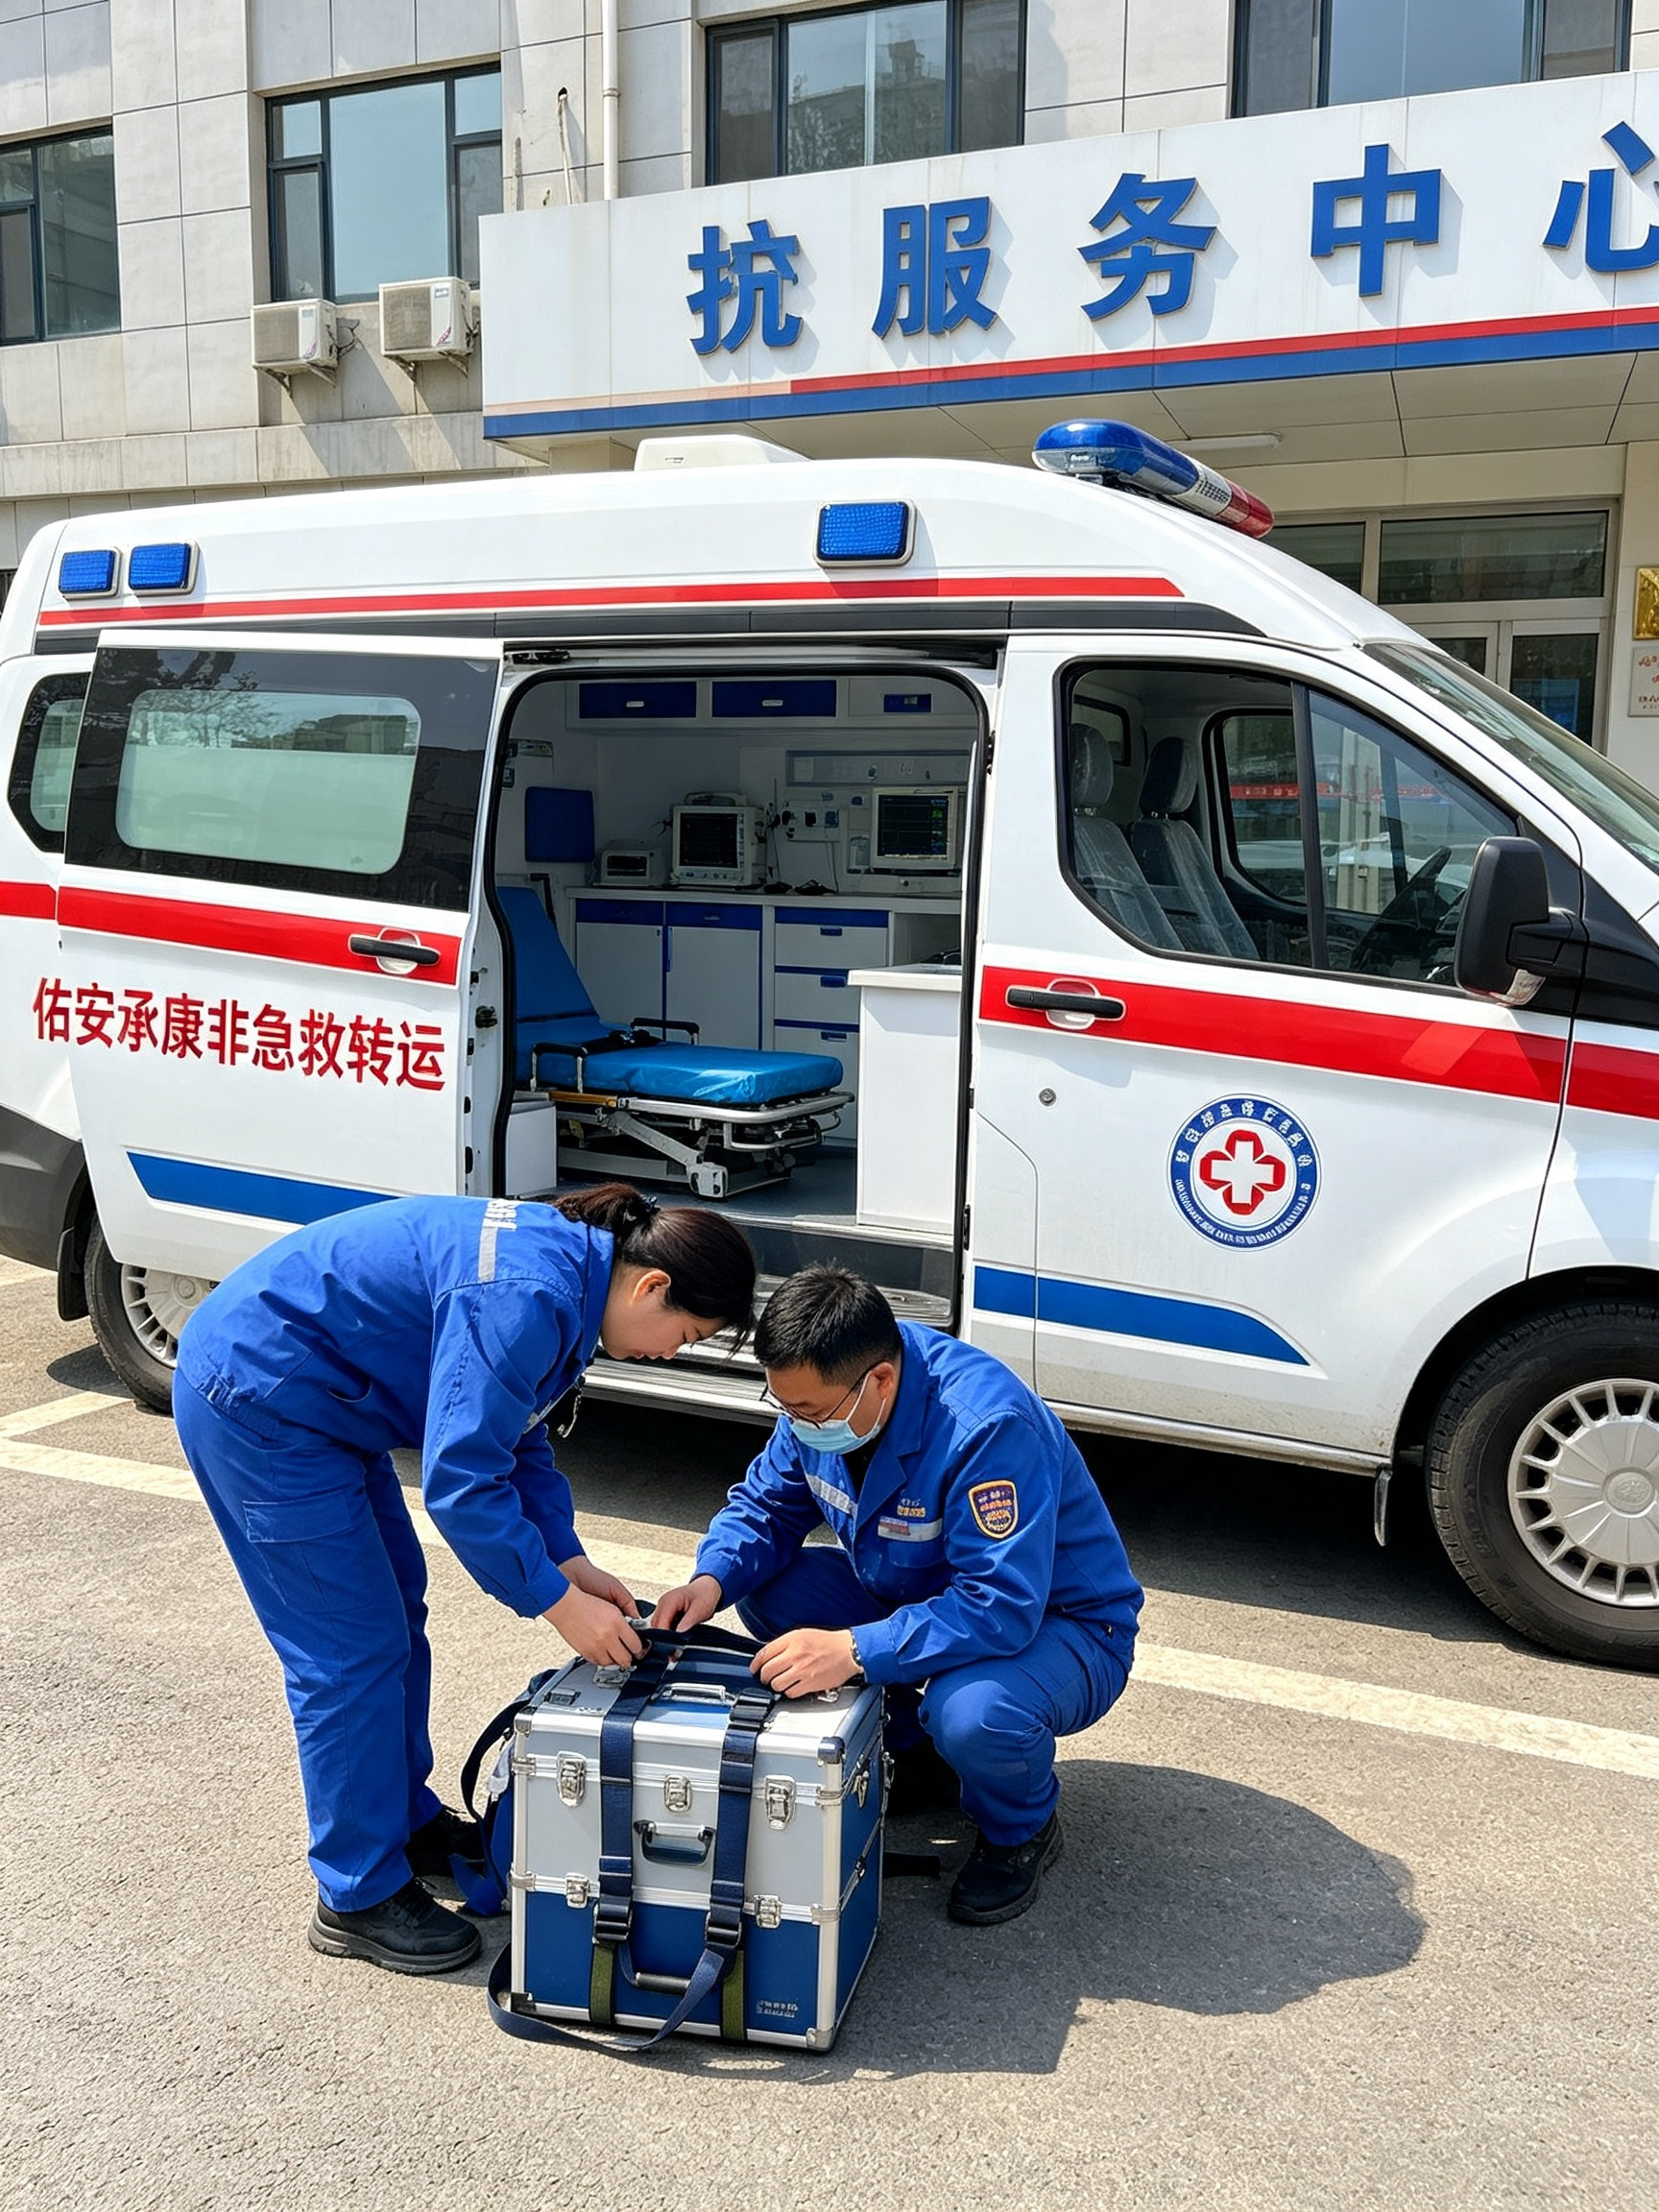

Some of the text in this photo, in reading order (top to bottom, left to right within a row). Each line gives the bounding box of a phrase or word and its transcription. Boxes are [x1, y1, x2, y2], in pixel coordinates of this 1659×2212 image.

[33, 977, 445, 1092] 佑安承康非急救转运
